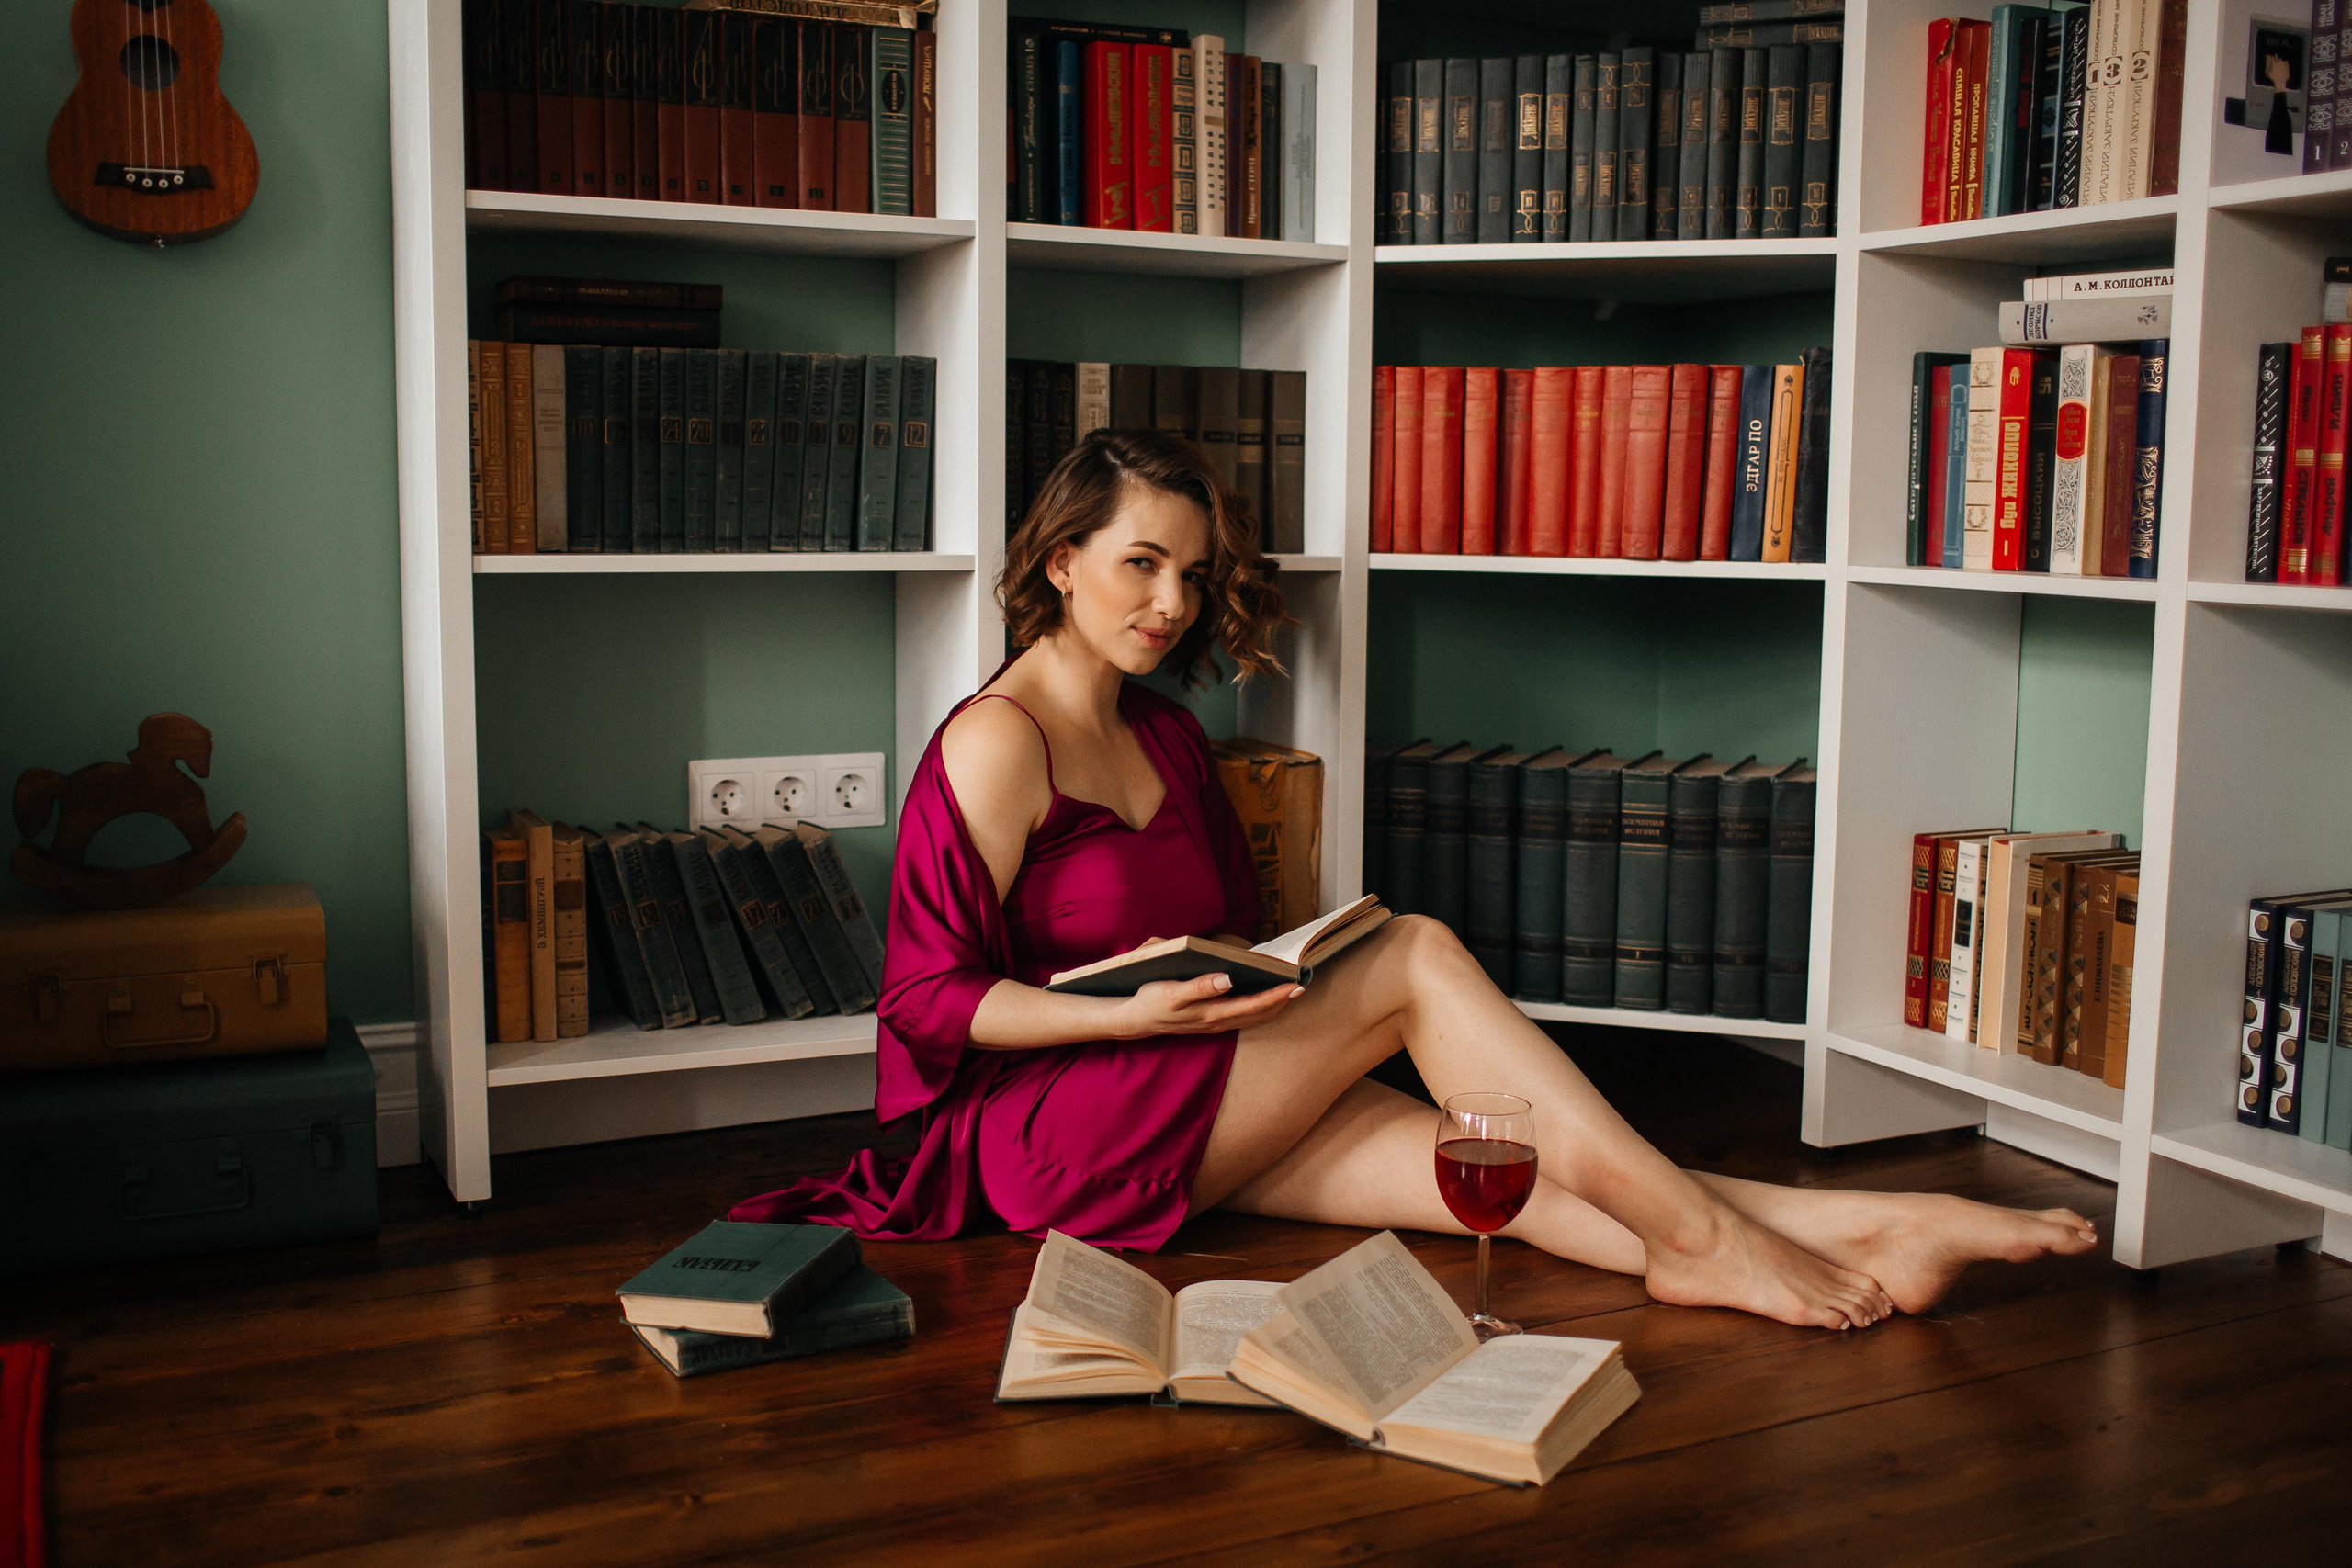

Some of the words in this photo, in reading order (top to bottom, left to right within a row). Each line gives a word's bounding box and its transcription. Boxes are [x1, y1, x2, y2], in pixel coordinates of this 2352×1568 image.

[2111, 12, 2120, 56] СОТВОРЕНИЕ
[2138, 6, 2146, 51] СОТВОРЕНИЕ
[2317, 4, 2327, 27] ИВАН
[2092, 18, 2102, 62] СОТВОРЕНИЕ
[922, 44, 933, 95] ЛОВУШКА
[1026, 54, 1035, 91] СЛОВАРЬ
[1953, 67, 1963, 116] СПЯЩАЯ
[1971, 83, 1980, 142] ПРОПАВШАЯ
[2085, 90, 2098, 152] ЗАКРУТКИН
[2103, 86, 2115, 149] ЗАКРУТКИН
[2131, 80, 2143, 144] ЗАКРУТКИН
[1951, 119, 1962, 182] КРАСАВИЦА
[1968, 148, 1977, 181] НИМФА
[2314, 145, 2320, 161] 1
[2340, 141, 2349, 155] 2
[2034, 304, 2042, 340] БОРИСОВ
[910, 427, 922, 445] 12
[1748, 419, 1762, 442] ПО
[1746, 445, 1760, 492] ЭДГАР
[1908, 425, 1917, 521] Сатирические
[2001, 421, 2021, 499] ЖАКОЛИО
[2323, 477, 2335, 537] Андрей
[2329, 373, 2344, 430] ИЛЬИН
[1999, 501, 2017, 529] Луи
[2031, 452, 2045, 540] ВЫСОЦКИЙ
[2254, 487, 2263, 533] ЗАРУБЕЖНЫЙ
[2292, 469, 2309, 545] СТРЕЛЬЦОВ
[2030, 545, 2040, 558] С.
[2251, 535, 2259, 570] ДЕТЕКТИВ
[2095, 931, 2104, 993] НИКОЛАЕВА
[2248, 942, 2257, 986] АЛЕКСАНДР
[2256, 942, 2265, 987] ПОПОВСКИЙ
[2290, 950, 2300, 996] ПОПОВСКИЙ
[672, 1257, 762, 1272] БАЛЬЗАК
